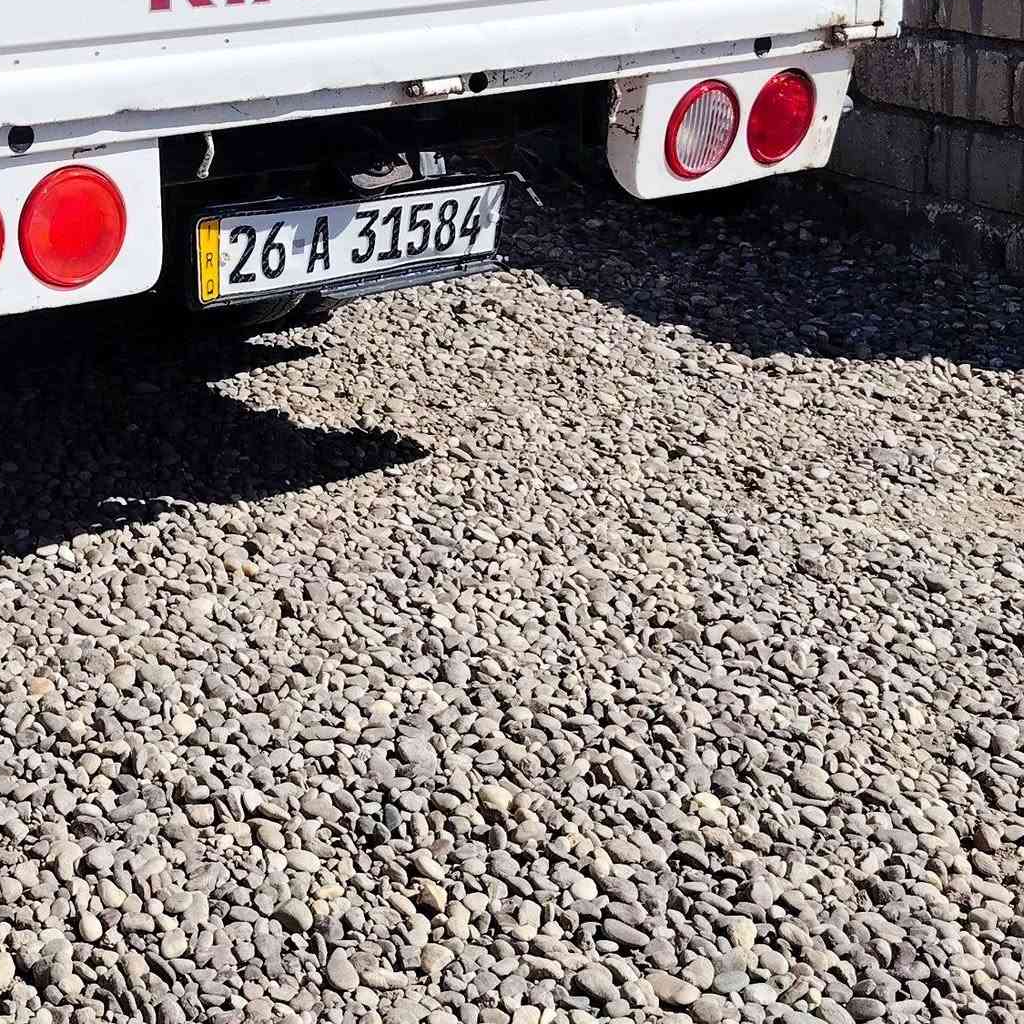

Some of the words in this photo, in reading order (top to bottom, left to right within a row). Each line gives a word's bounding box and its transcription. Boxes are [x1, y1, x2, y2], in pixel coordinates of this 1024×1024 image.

[229, 221, 287, 284] 26
[307, 215, 331, 274] A
[351, 195, 483, 265] 31584
